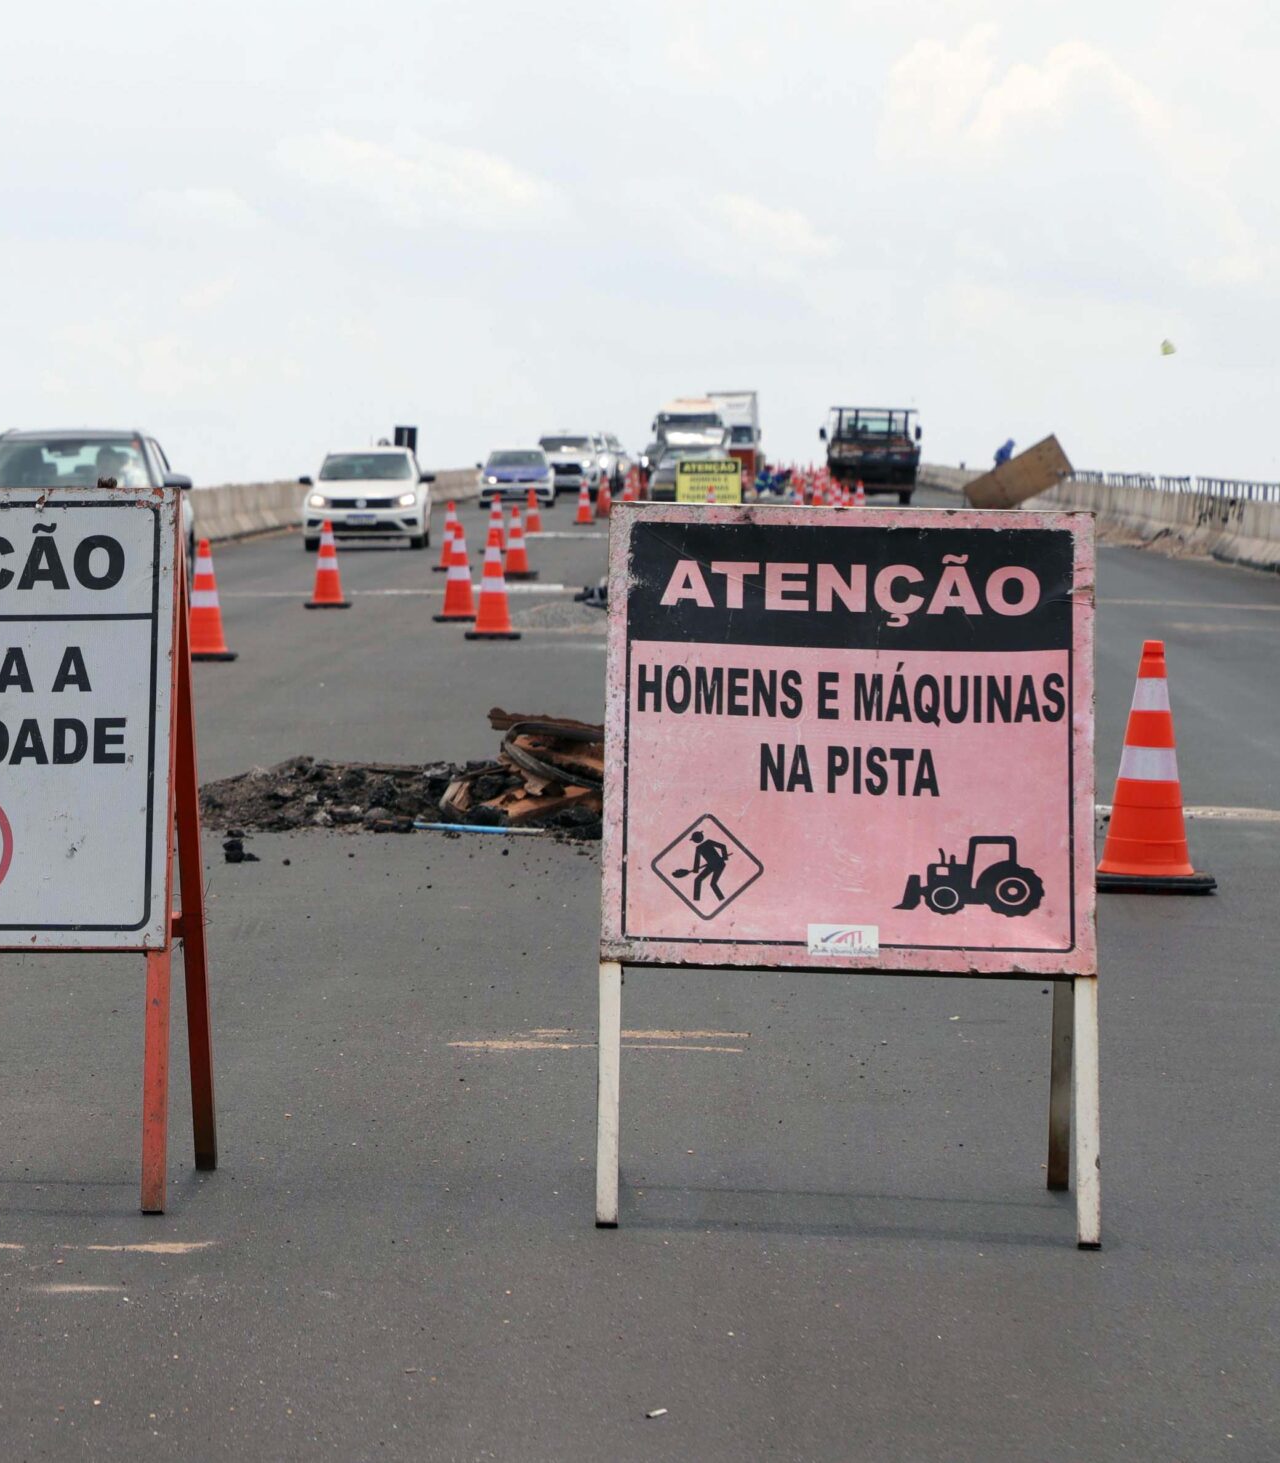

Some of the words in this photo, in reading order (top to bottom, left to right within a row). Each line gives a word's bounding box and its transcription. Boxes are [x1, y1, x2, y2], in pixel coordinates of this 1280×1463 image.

[659, 554, 1041, 628] ATENÇÃO
[51, 646, 93, 693] A
[637, 664, 803, 719] HOMENS
[817, 671, 840, 720] E
[854, 661, 1066, 727] MÁQUINAS
[760, 743, 814, 793] NA
[827, 745, 940, 797] PISTA
